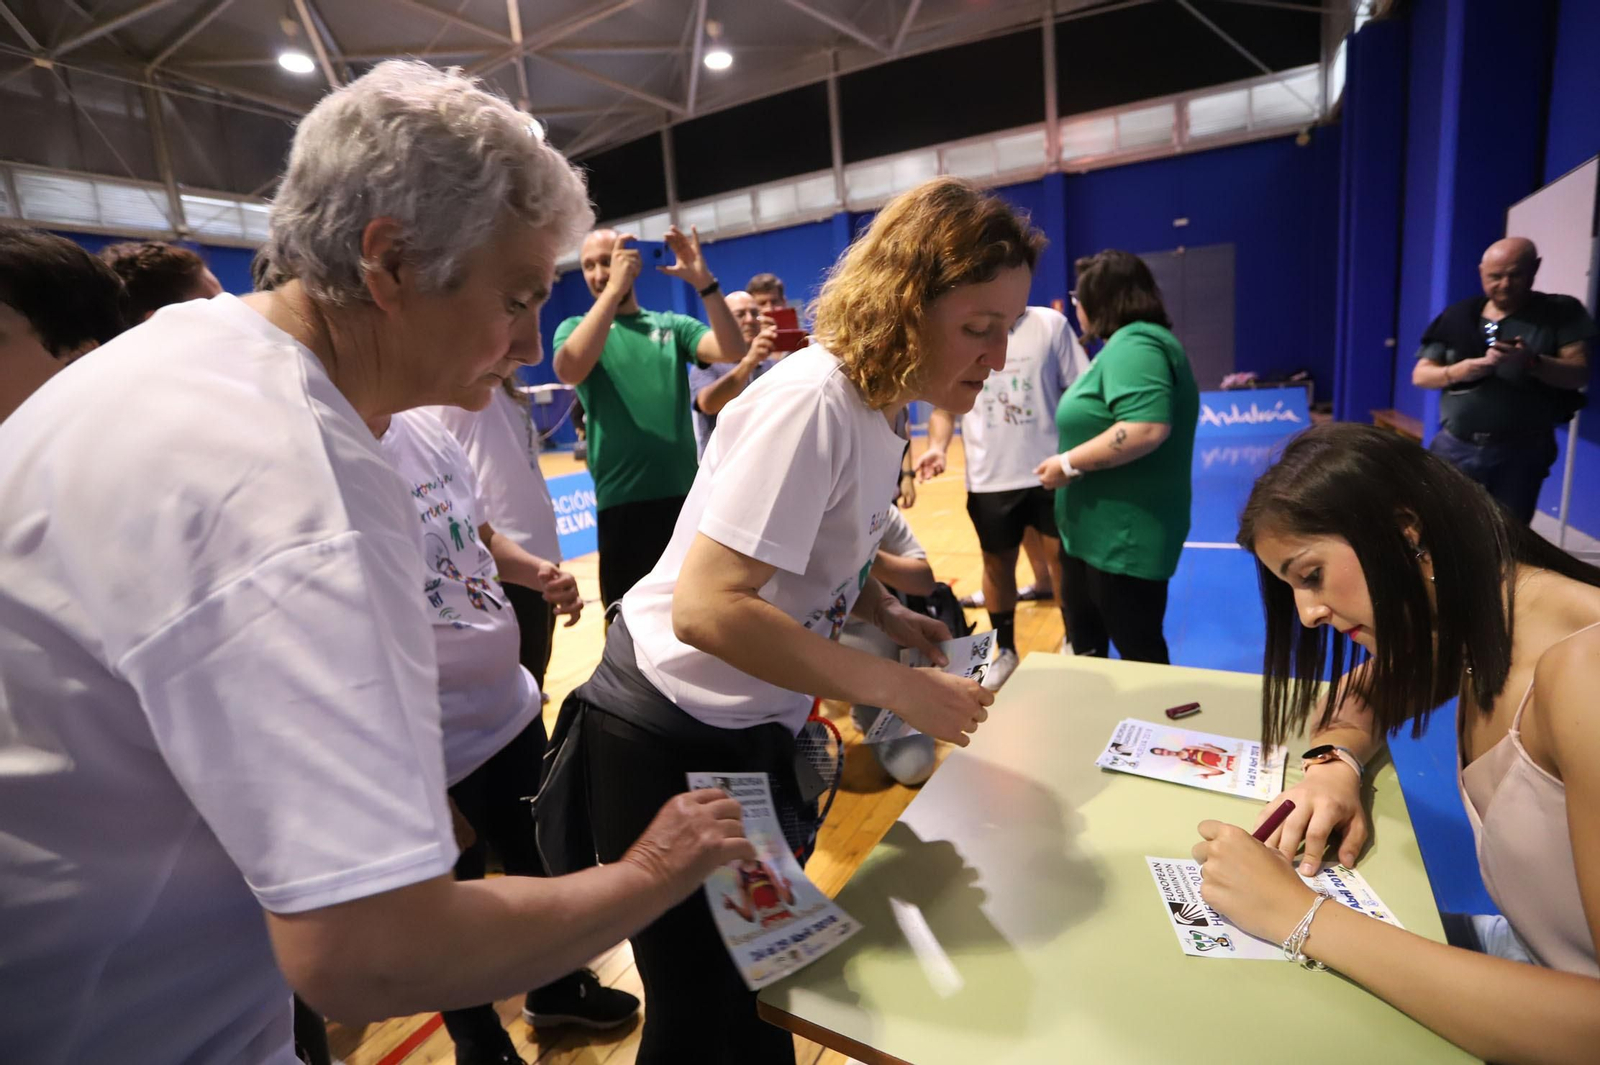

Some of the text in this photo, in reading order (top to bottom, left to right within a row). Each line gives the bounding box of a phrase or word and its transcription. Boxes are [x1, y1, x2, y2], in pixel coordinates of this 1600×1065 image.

[1200, 400, 1302, 427] Andalucía
[556, 510, 597, 536] ELVA
[1152, 861, 1176, 902] EUROPEAN
[1164, 863, 1188, 903] BADMINTON
[1185, 865, 1203, 887] 2018
[1323, 868, 1347, 888] 2018
[1338, 889, 1363, 910] Abril
